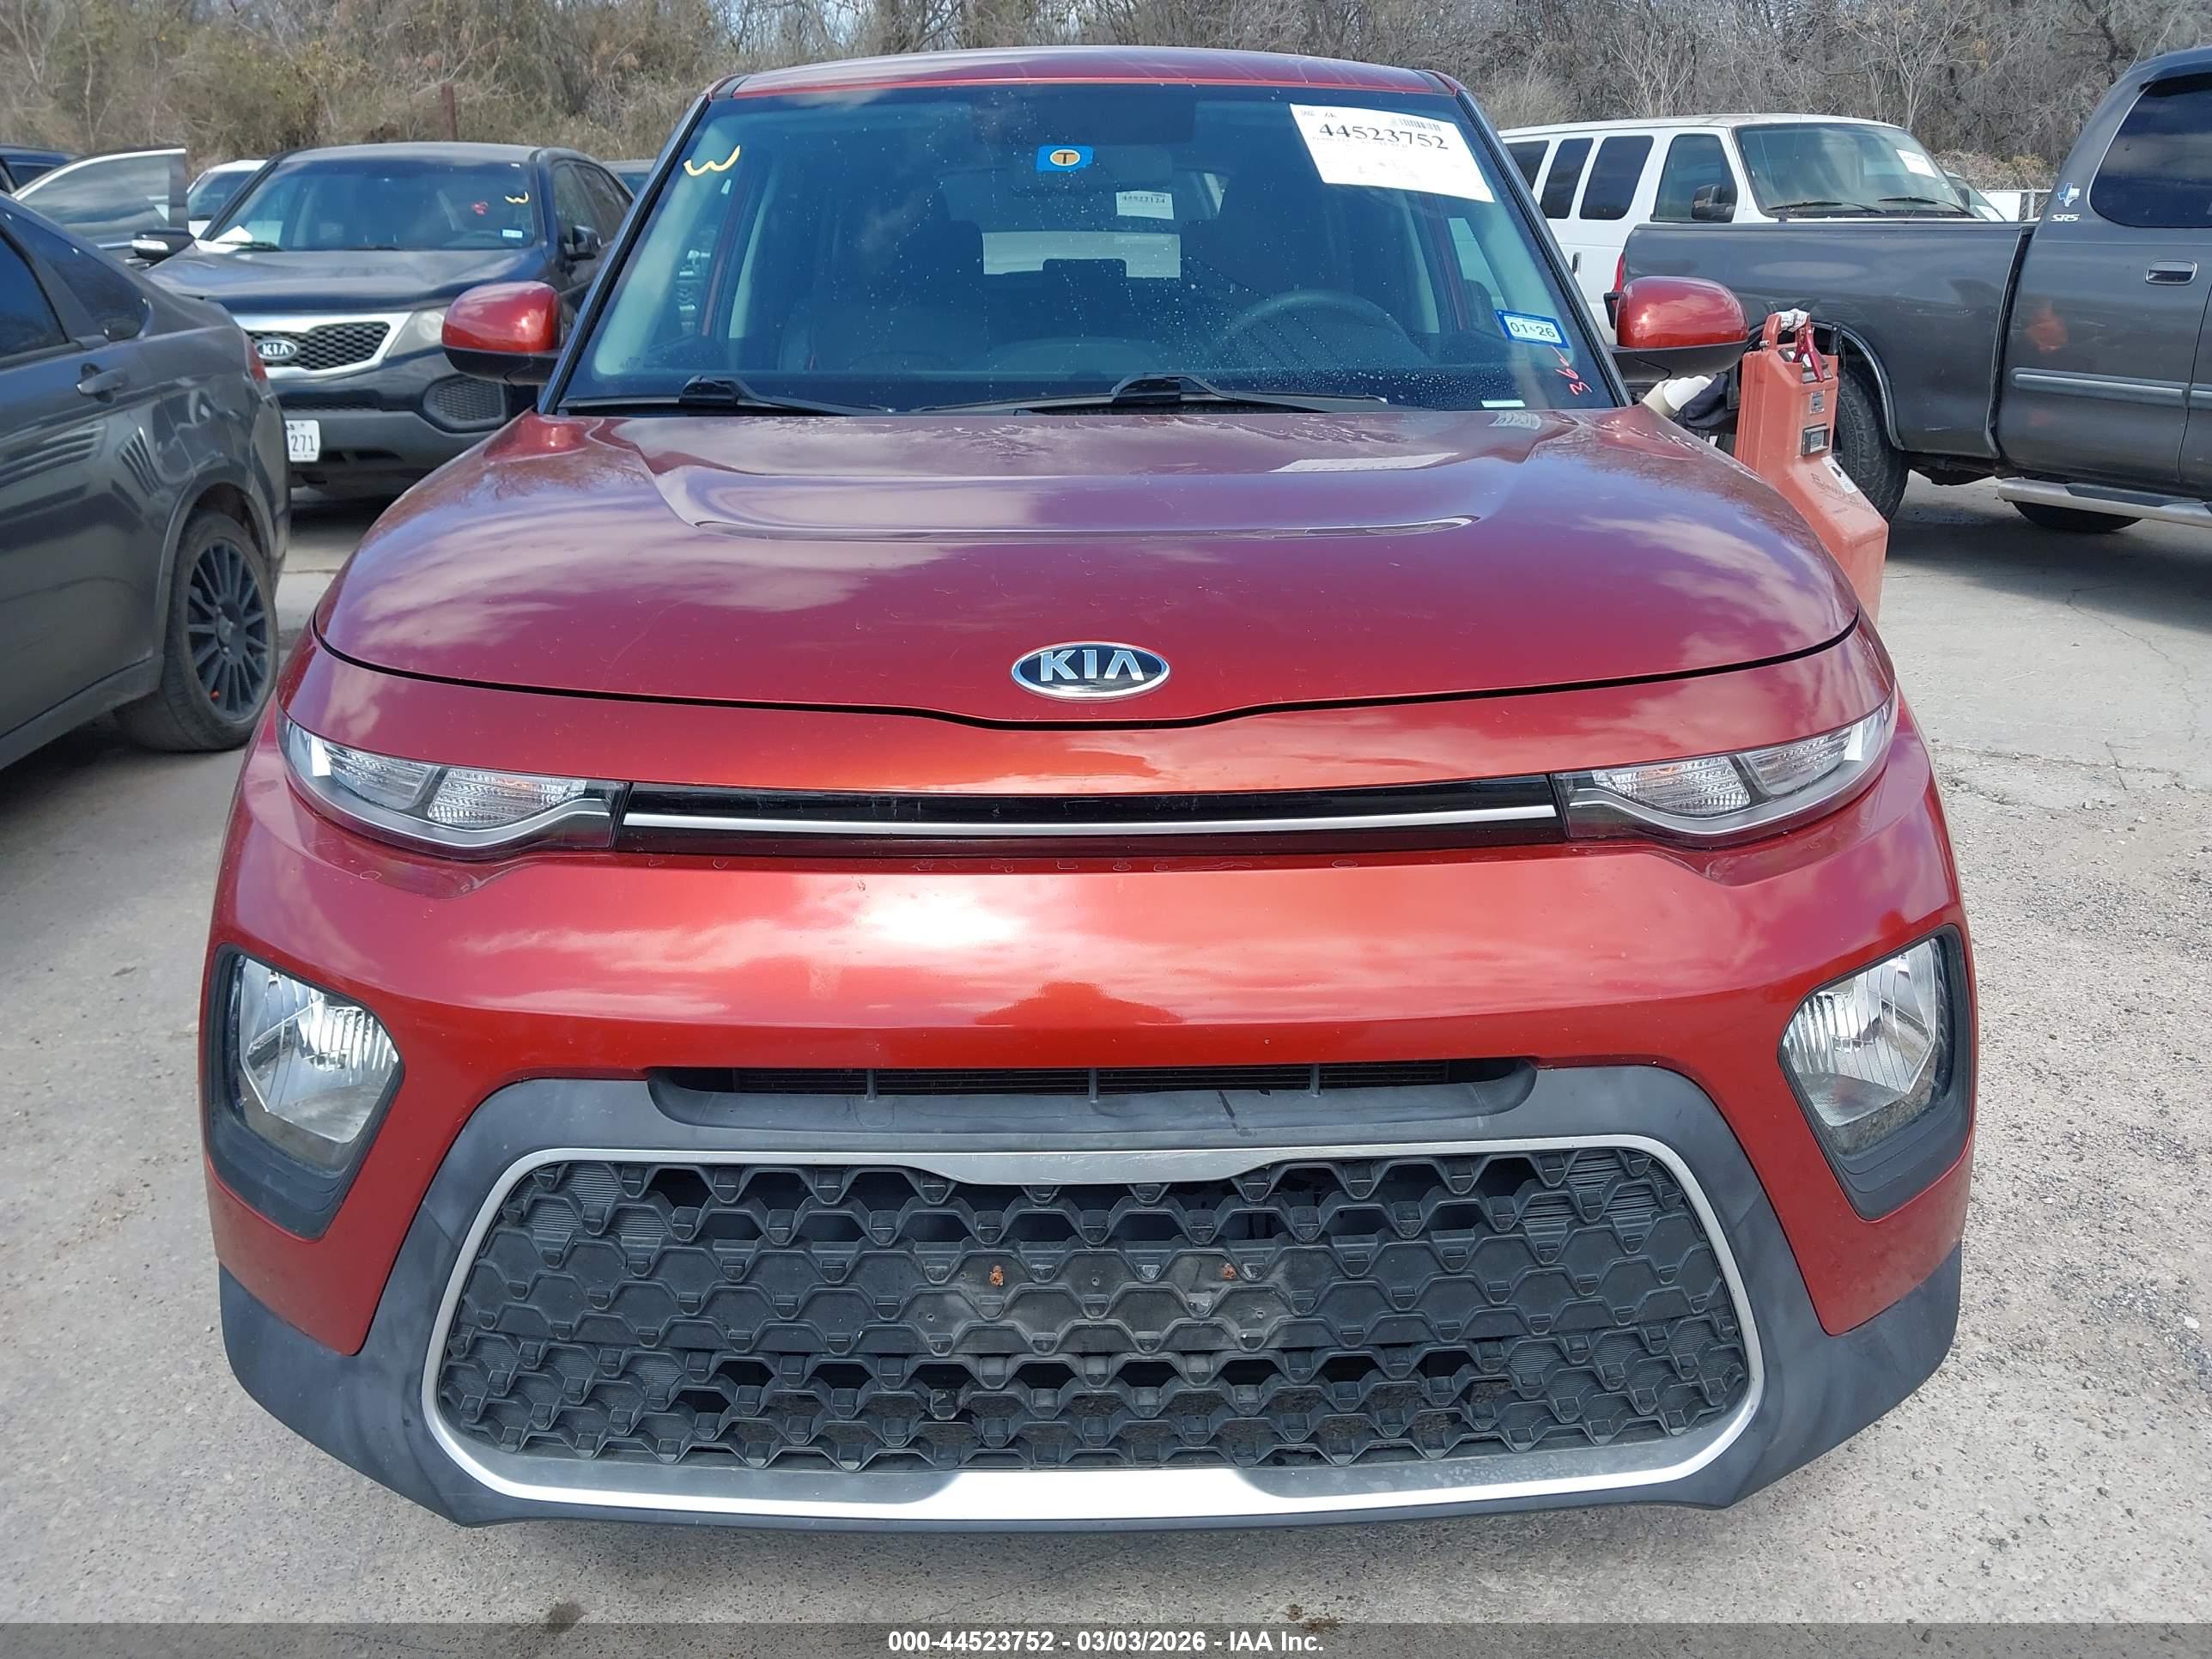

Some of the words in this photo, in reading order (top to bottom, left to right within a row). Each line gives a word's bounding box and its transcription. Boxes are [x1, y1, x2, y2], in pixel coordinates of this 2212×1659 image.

[1319, 123, 1449, 149] 44523752
[1056, 152, 1076, 164] T
[2051, 214, 2080, 222] SR5
[262, 344, 289, 356] KIA
[290, 434, 316, 453] 271
[1039, 649, 1146, 682] KIA
